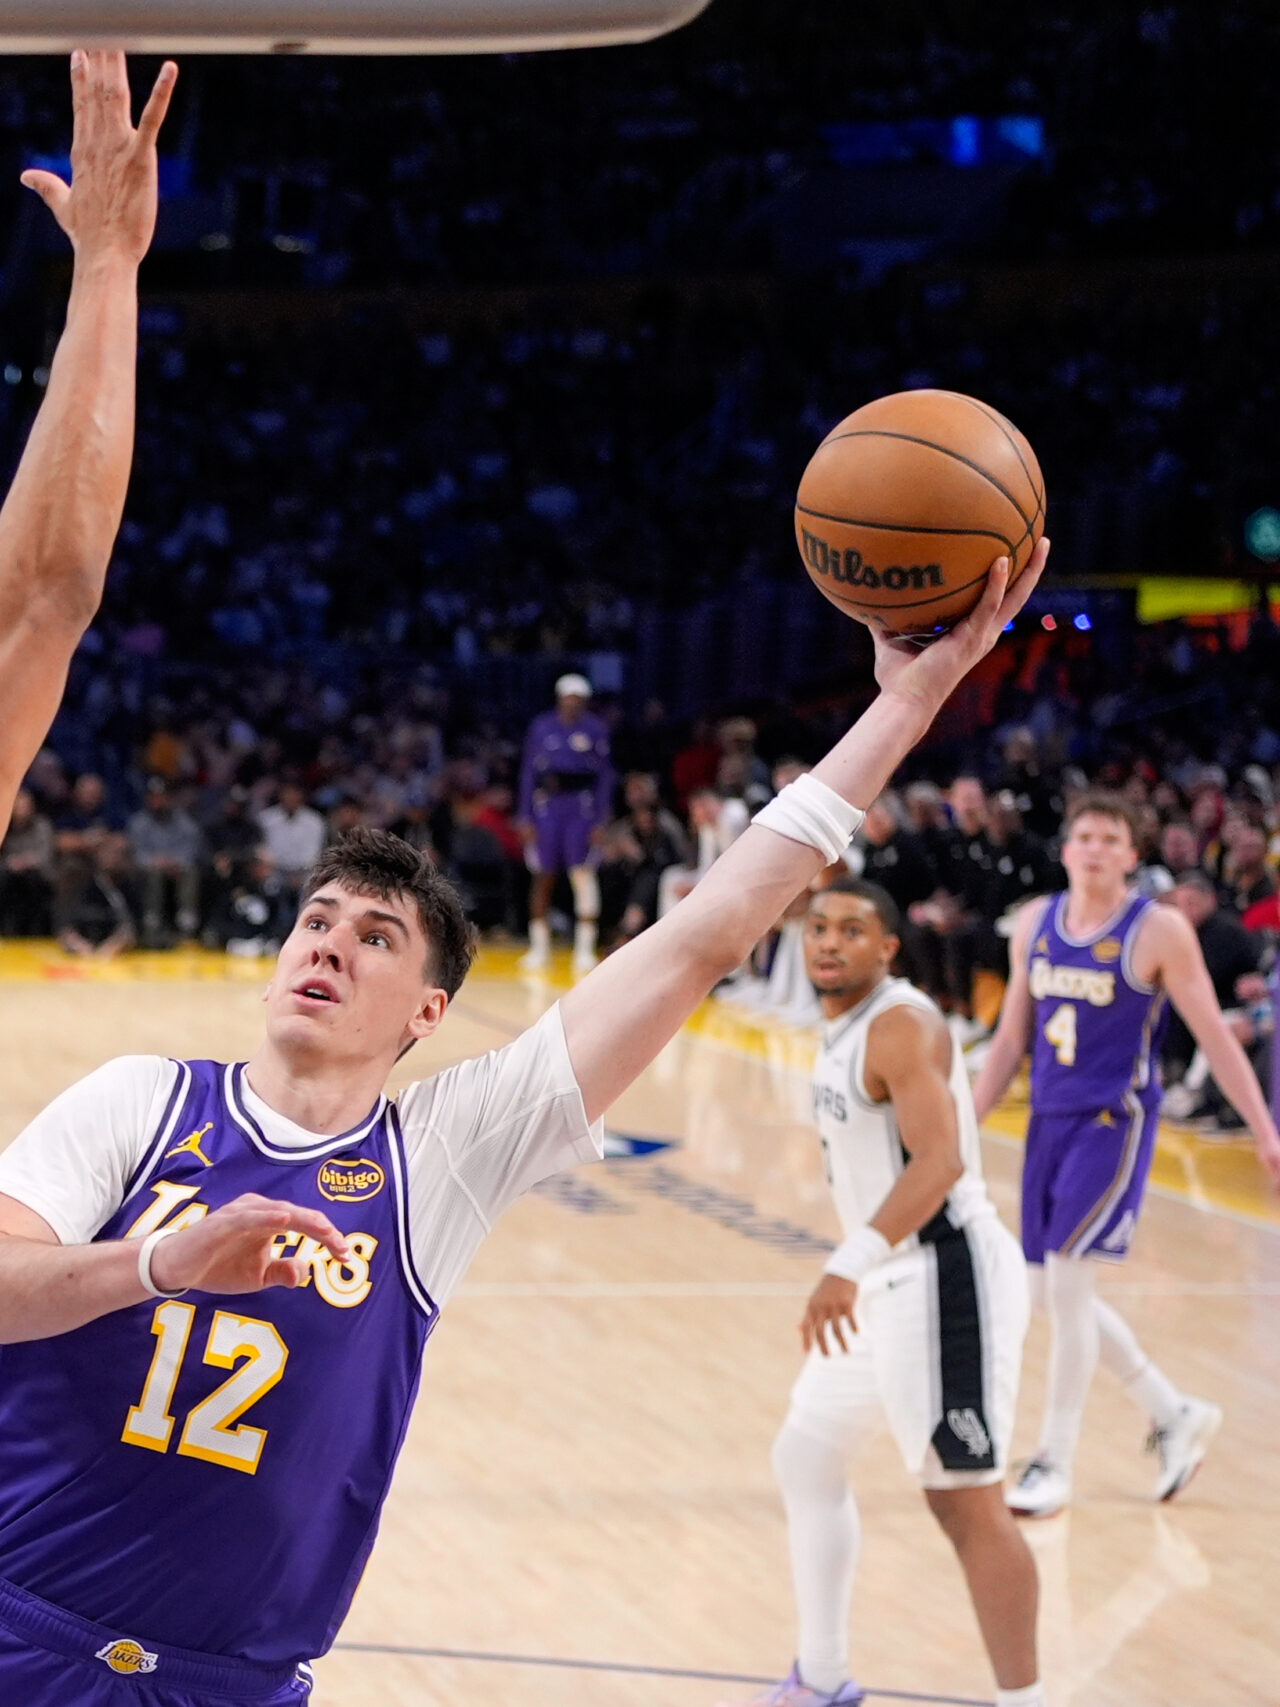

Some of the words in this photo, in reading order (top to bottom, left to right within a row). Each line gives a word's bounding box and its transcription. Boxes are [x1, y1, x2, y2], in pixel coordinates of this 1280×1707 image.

[801, 525, 946, 590] Wilson
[1043, 1003, 1078, 1066] 4
[322, 1166, 379, 1190] bibigo
[120, 1299, 290, 1476] 12
[99, 1644, 154, 1673] LAKERS
